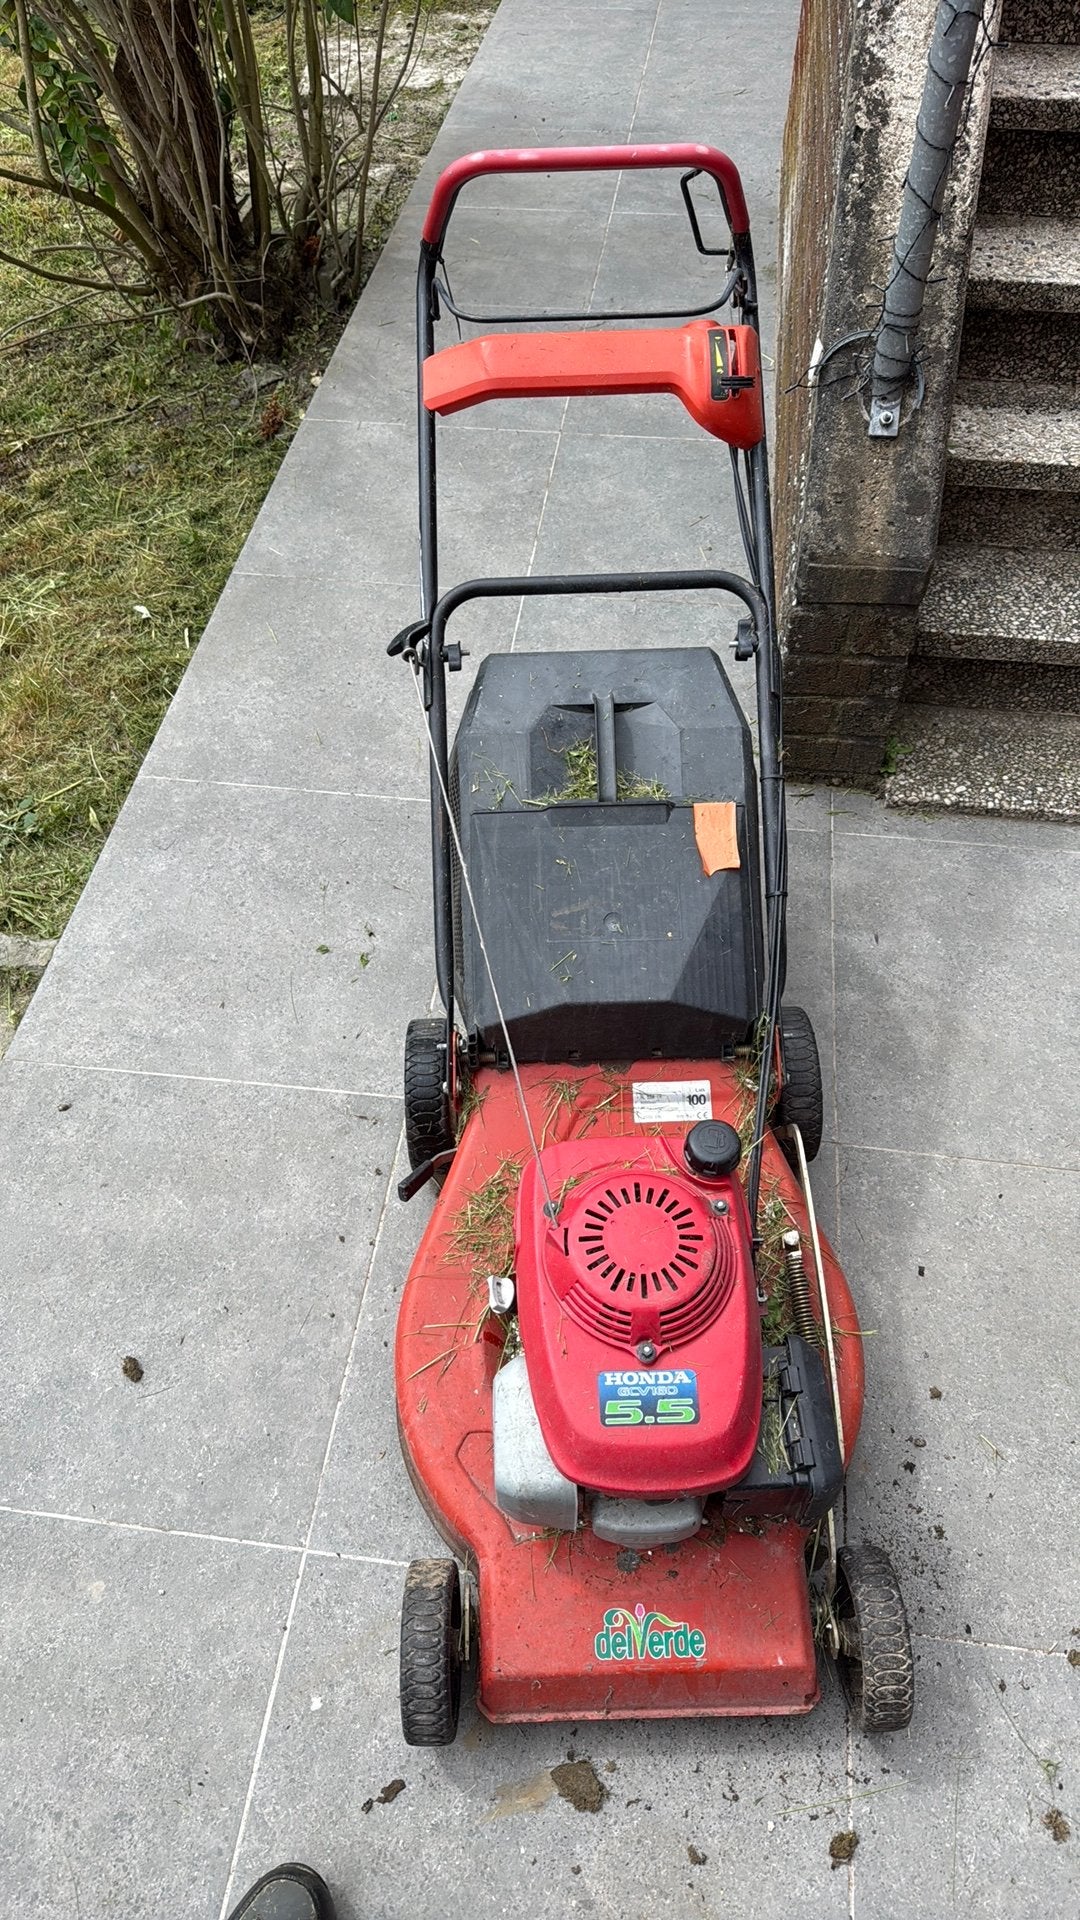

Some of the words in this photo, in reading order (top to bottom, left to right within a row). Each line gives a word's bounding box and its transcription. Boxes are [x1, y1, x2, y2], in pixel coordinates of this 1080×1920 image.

[686, 1094, 707, 1105] 100
[696, 1111, 708, 1119] CE
[604, 1371, 692, 1386] HONDA
[617, 1385, 679, 1397] GCV160
[605, 1398, 696, 1425] 5.5
[594, 1607, 706, 1660] delVerde
